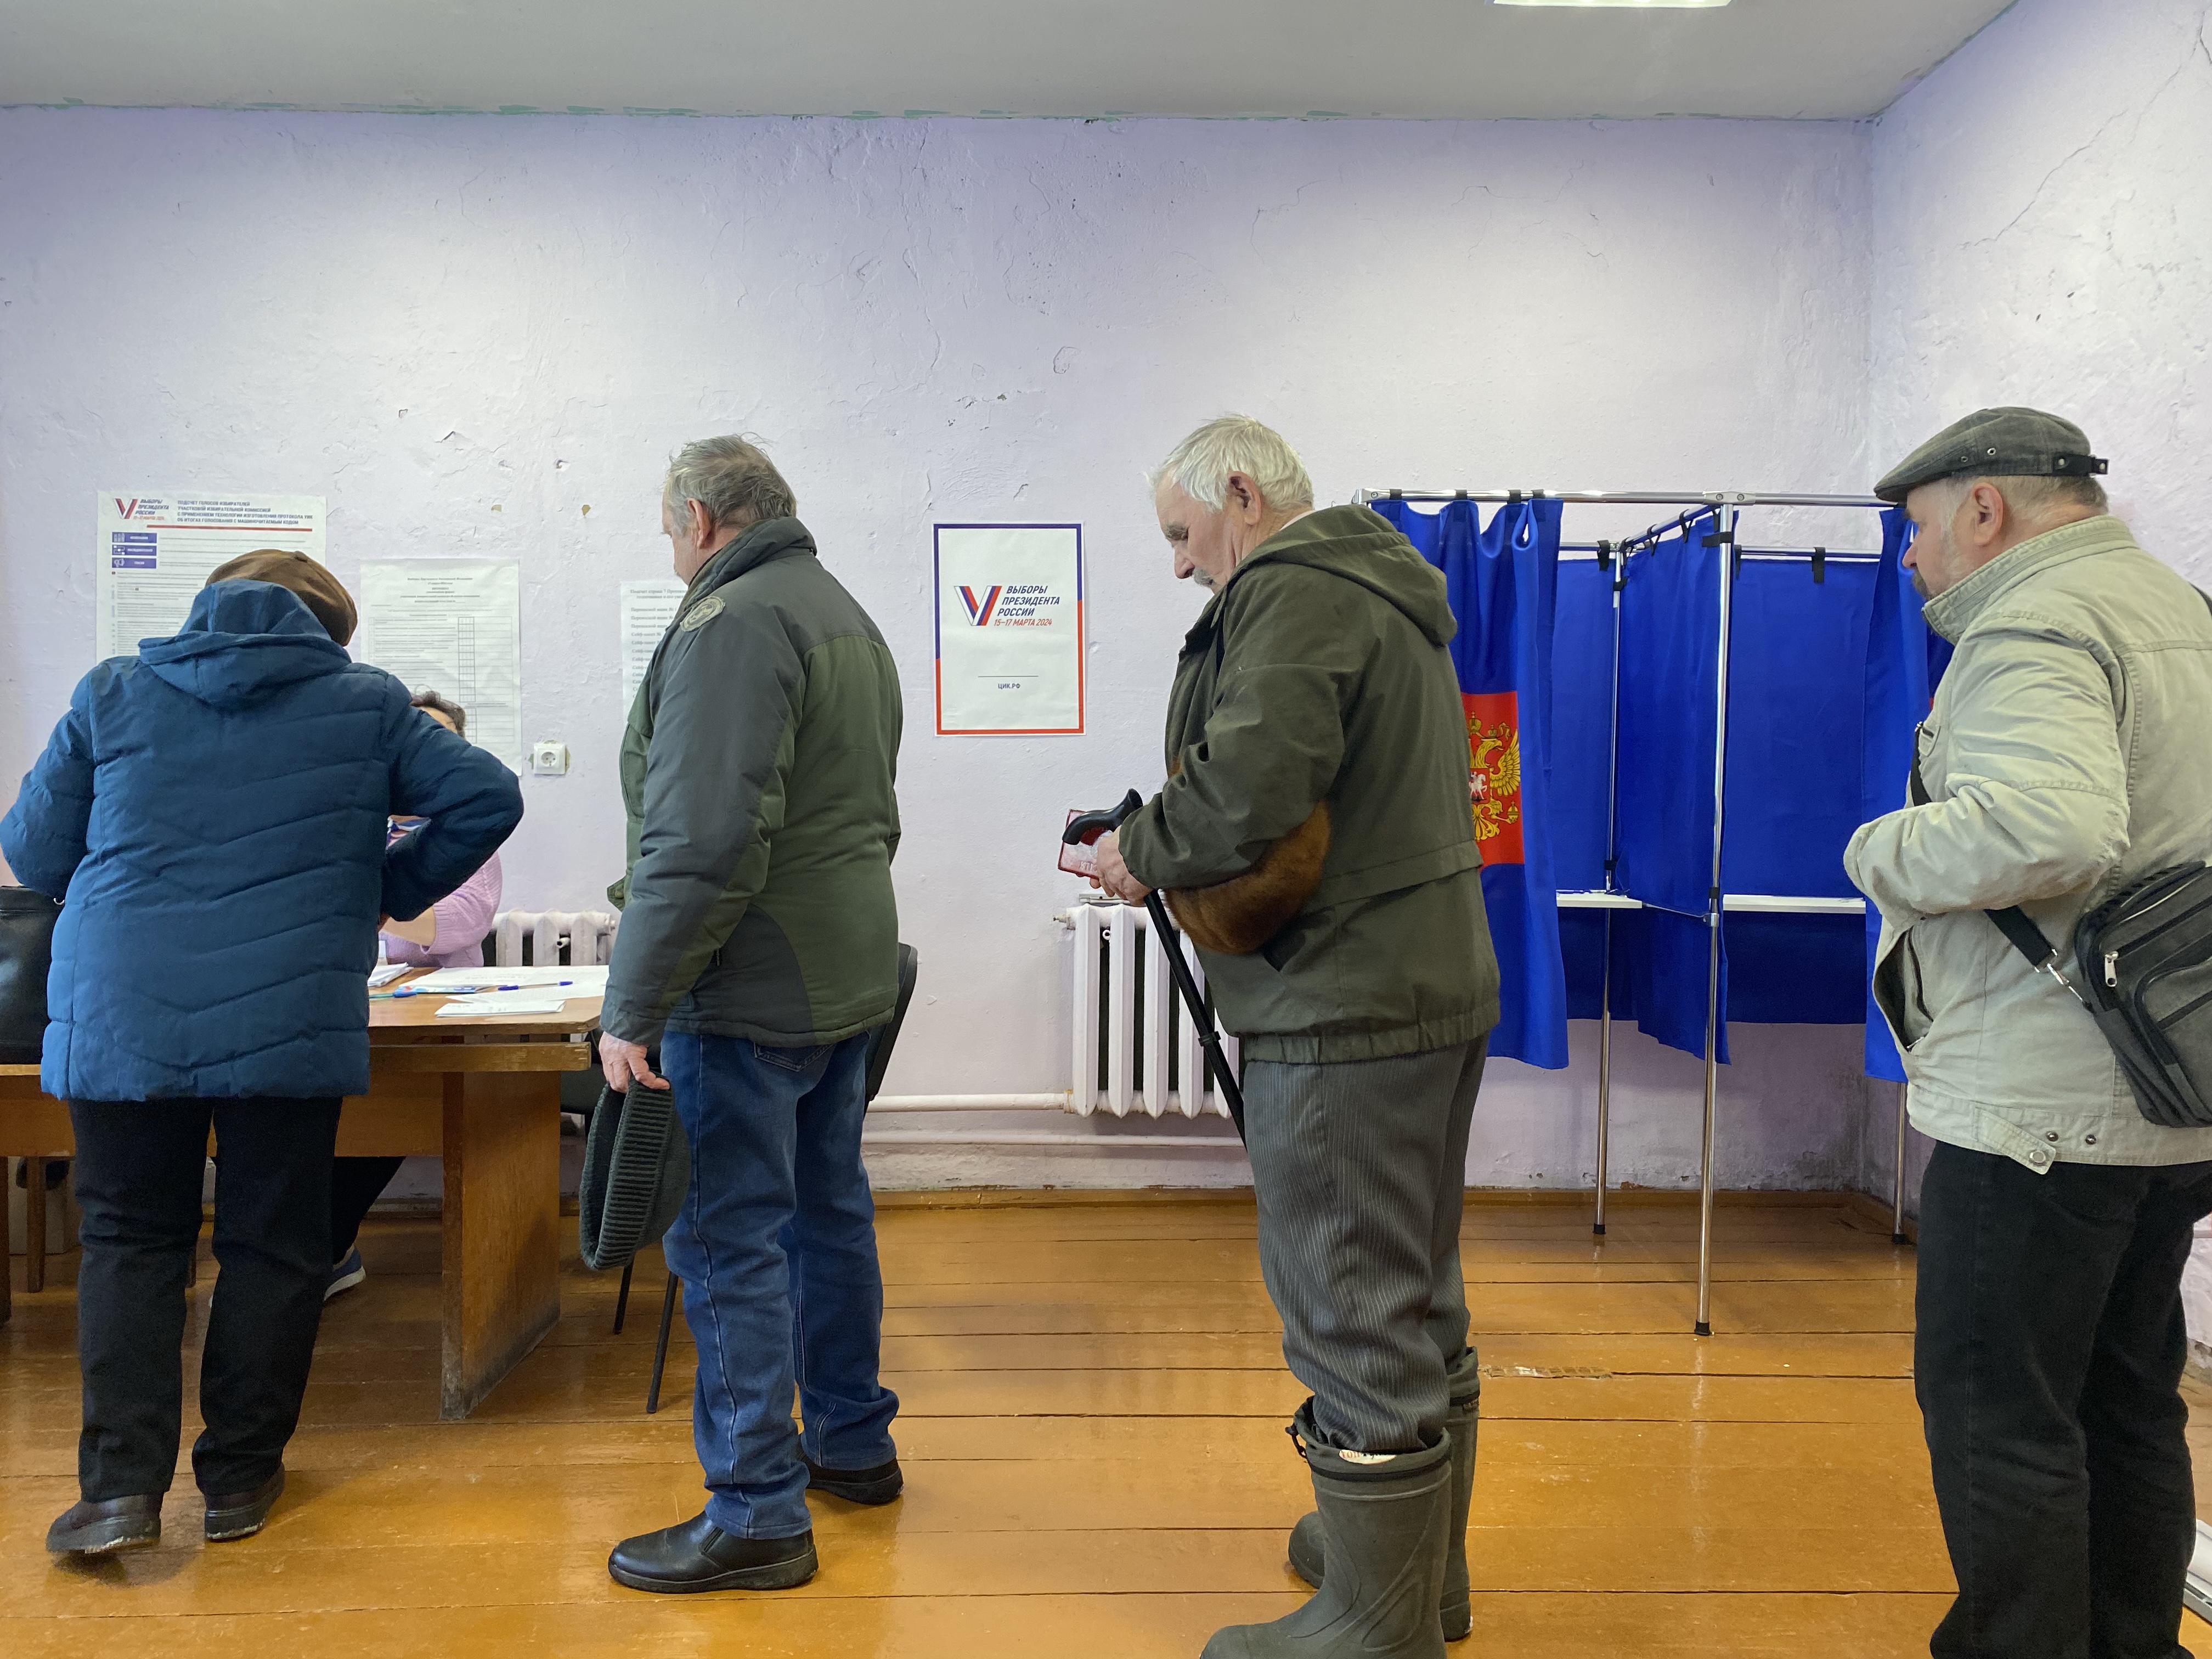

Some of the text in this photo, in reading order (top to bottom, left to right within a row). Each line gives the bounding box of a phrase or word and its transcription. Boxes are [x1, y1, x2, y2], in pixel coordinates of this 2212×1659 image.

[1006, 585, 1048, 594] ВЫБОРЫ
[1001, 596, 1060, 606] ПРЕЗИДЕНТА
[997, 608, 1035, 617] РОССИИ
